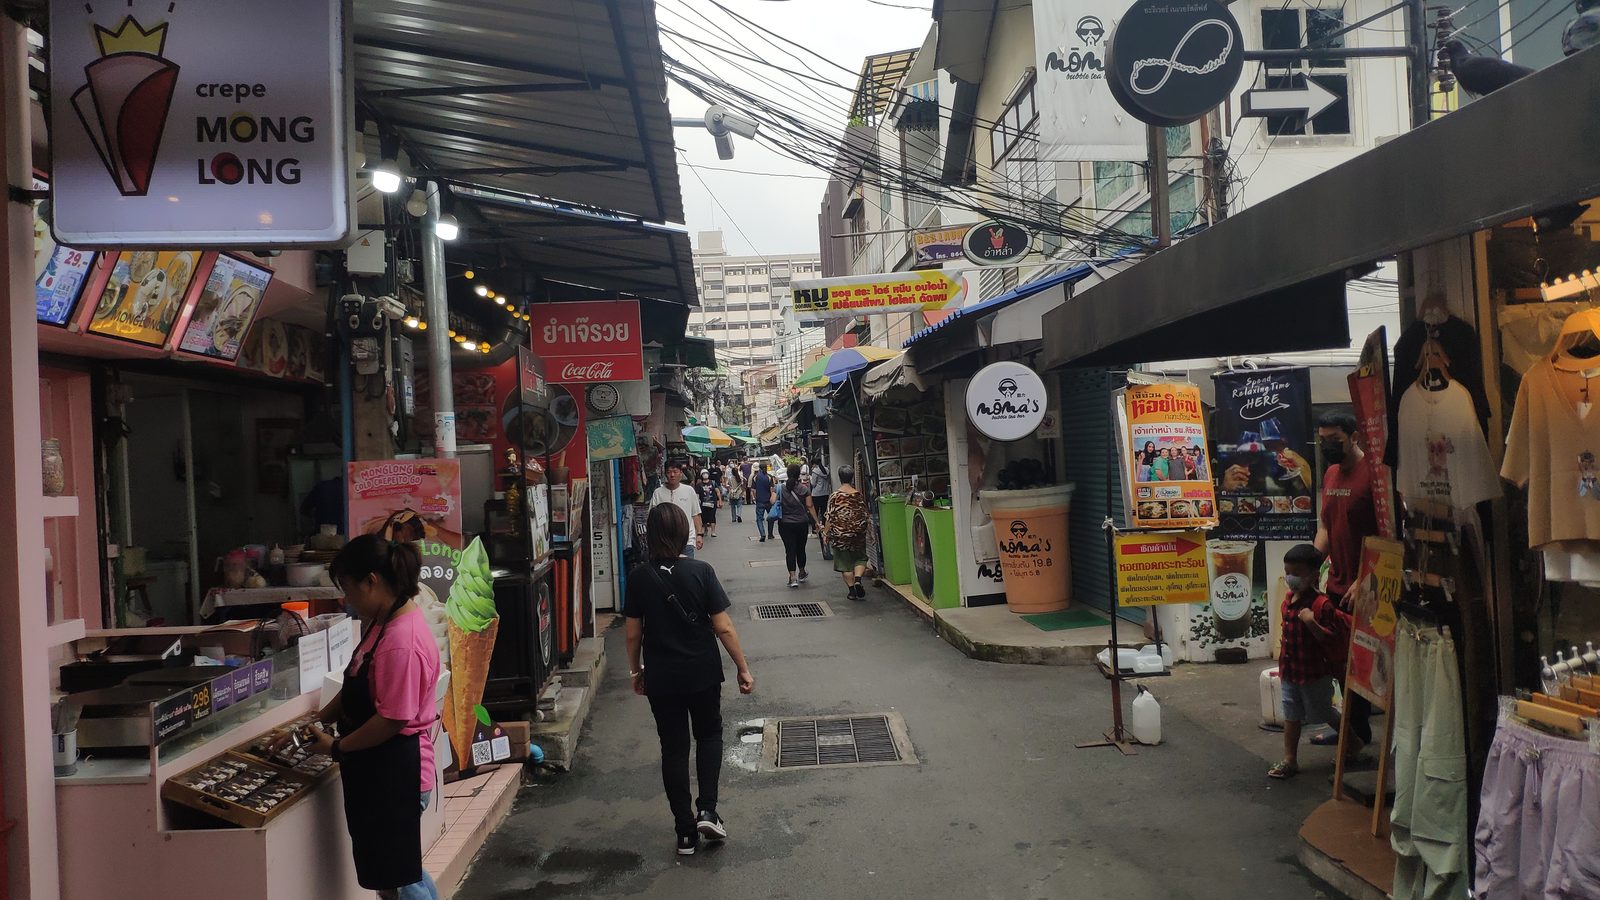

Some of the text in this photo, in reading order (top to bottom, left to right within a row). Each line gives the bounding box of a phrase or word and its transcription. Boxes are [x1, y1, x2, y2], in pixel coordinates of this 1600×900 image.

[196, 82, 266, 103] crepe
[197, 115, 315, 143] MONG
[198, 157, 301, 185] LONG
[794, 288, 829, 308] หมู
[543, 316, 629, 345] ยำเจ๊รวย
[1232, 381, 1291, 398] Relaxing Time
[1246, 375, 1272, 388] Spend
[1246, 394, 1280, 409] HERE
[361, 464, 413, 479] MONGLONG
